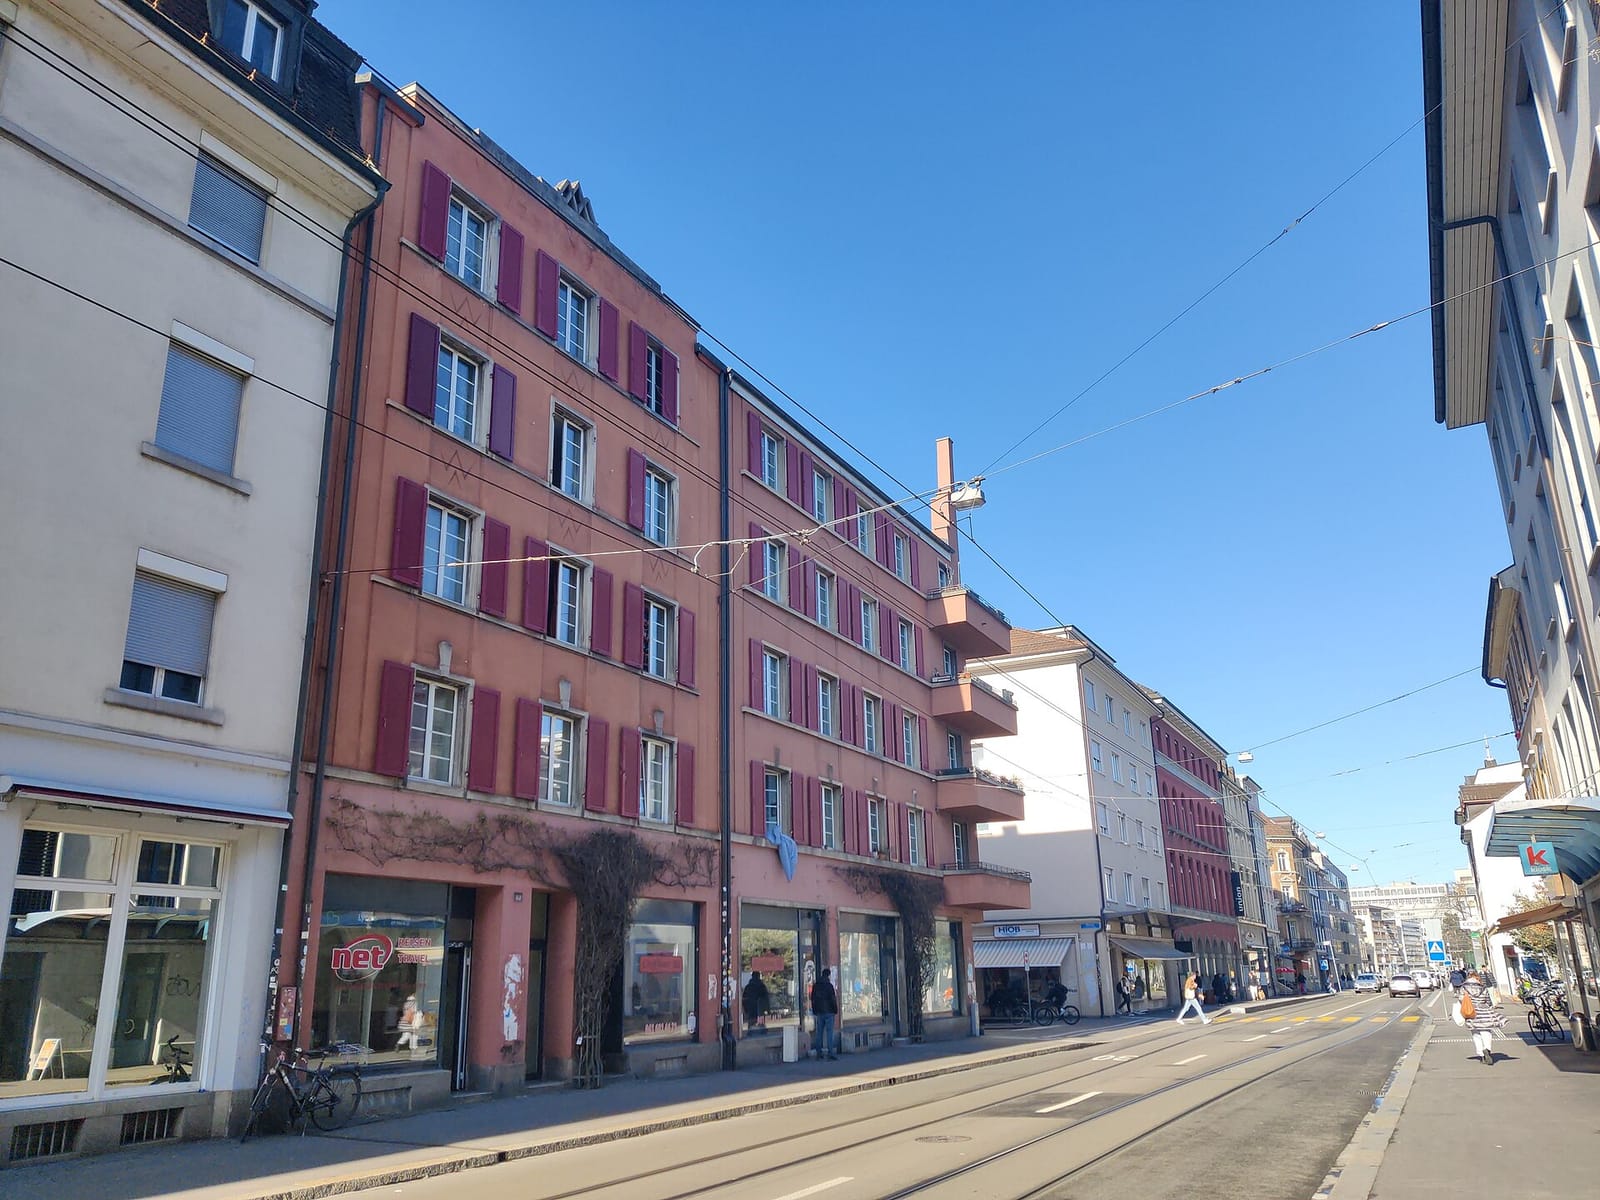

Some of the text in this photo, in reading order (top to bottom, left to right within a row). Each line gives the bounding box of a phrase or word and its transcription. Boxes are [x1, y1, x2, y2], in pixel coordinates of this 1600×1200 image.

[1236, 886, 1244, 912] union
[398, 937, 432, 948] REISEN
[331, 945, 385, 970] net
[398, 954, 430, 964] TRAVEL
